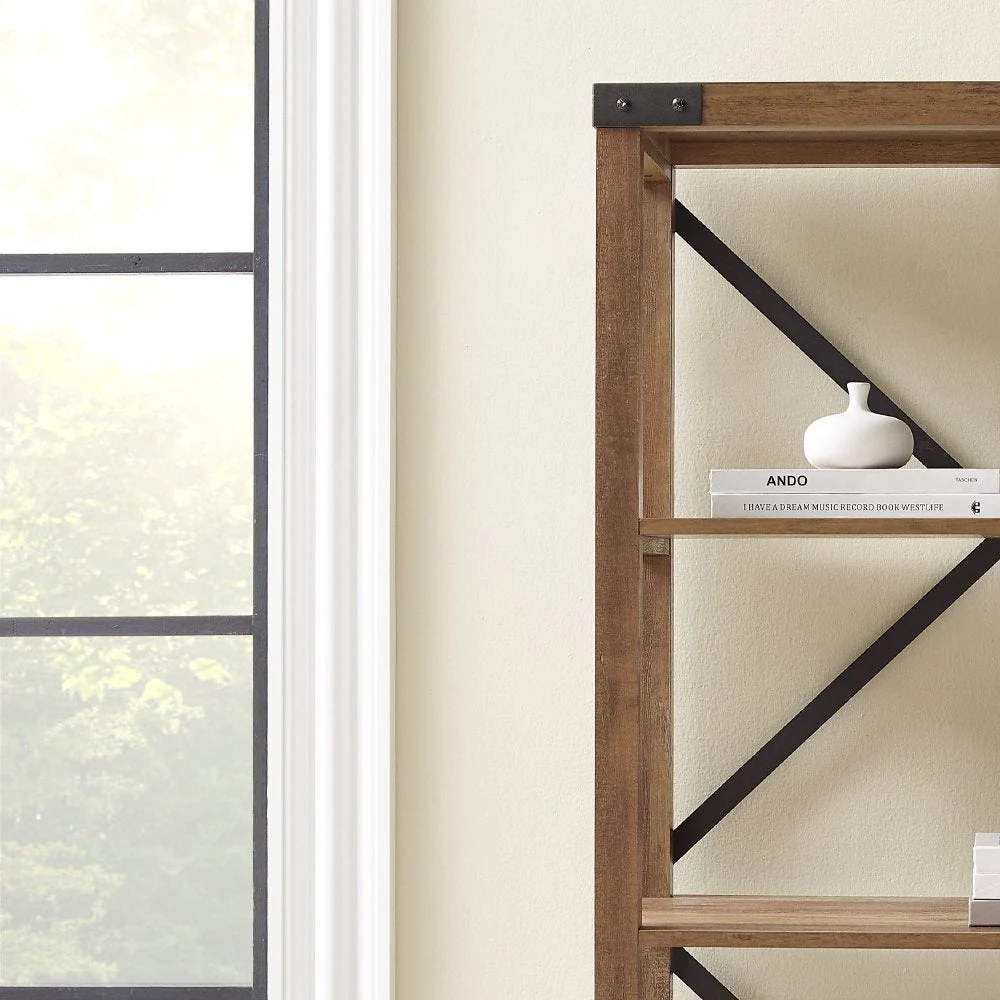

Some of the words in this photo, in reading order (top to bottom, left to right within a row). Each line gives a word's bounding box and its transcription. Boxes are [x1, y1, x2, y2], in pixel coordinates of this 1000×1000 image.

[767, 475, 808, 486] ANDO
[743, 503, 747, 511] I
[748, 503, 771, 511] HAVE
[772, 503, 778, 511] A
[780, 503, 810, 511] DREAM
[812, 503, 839, 511] MUSIC
[840, 503, 875, 511] RECORD
[876, 503, 900, 511] BOOK
[901, 503, 944, 511] WESTLIFE
